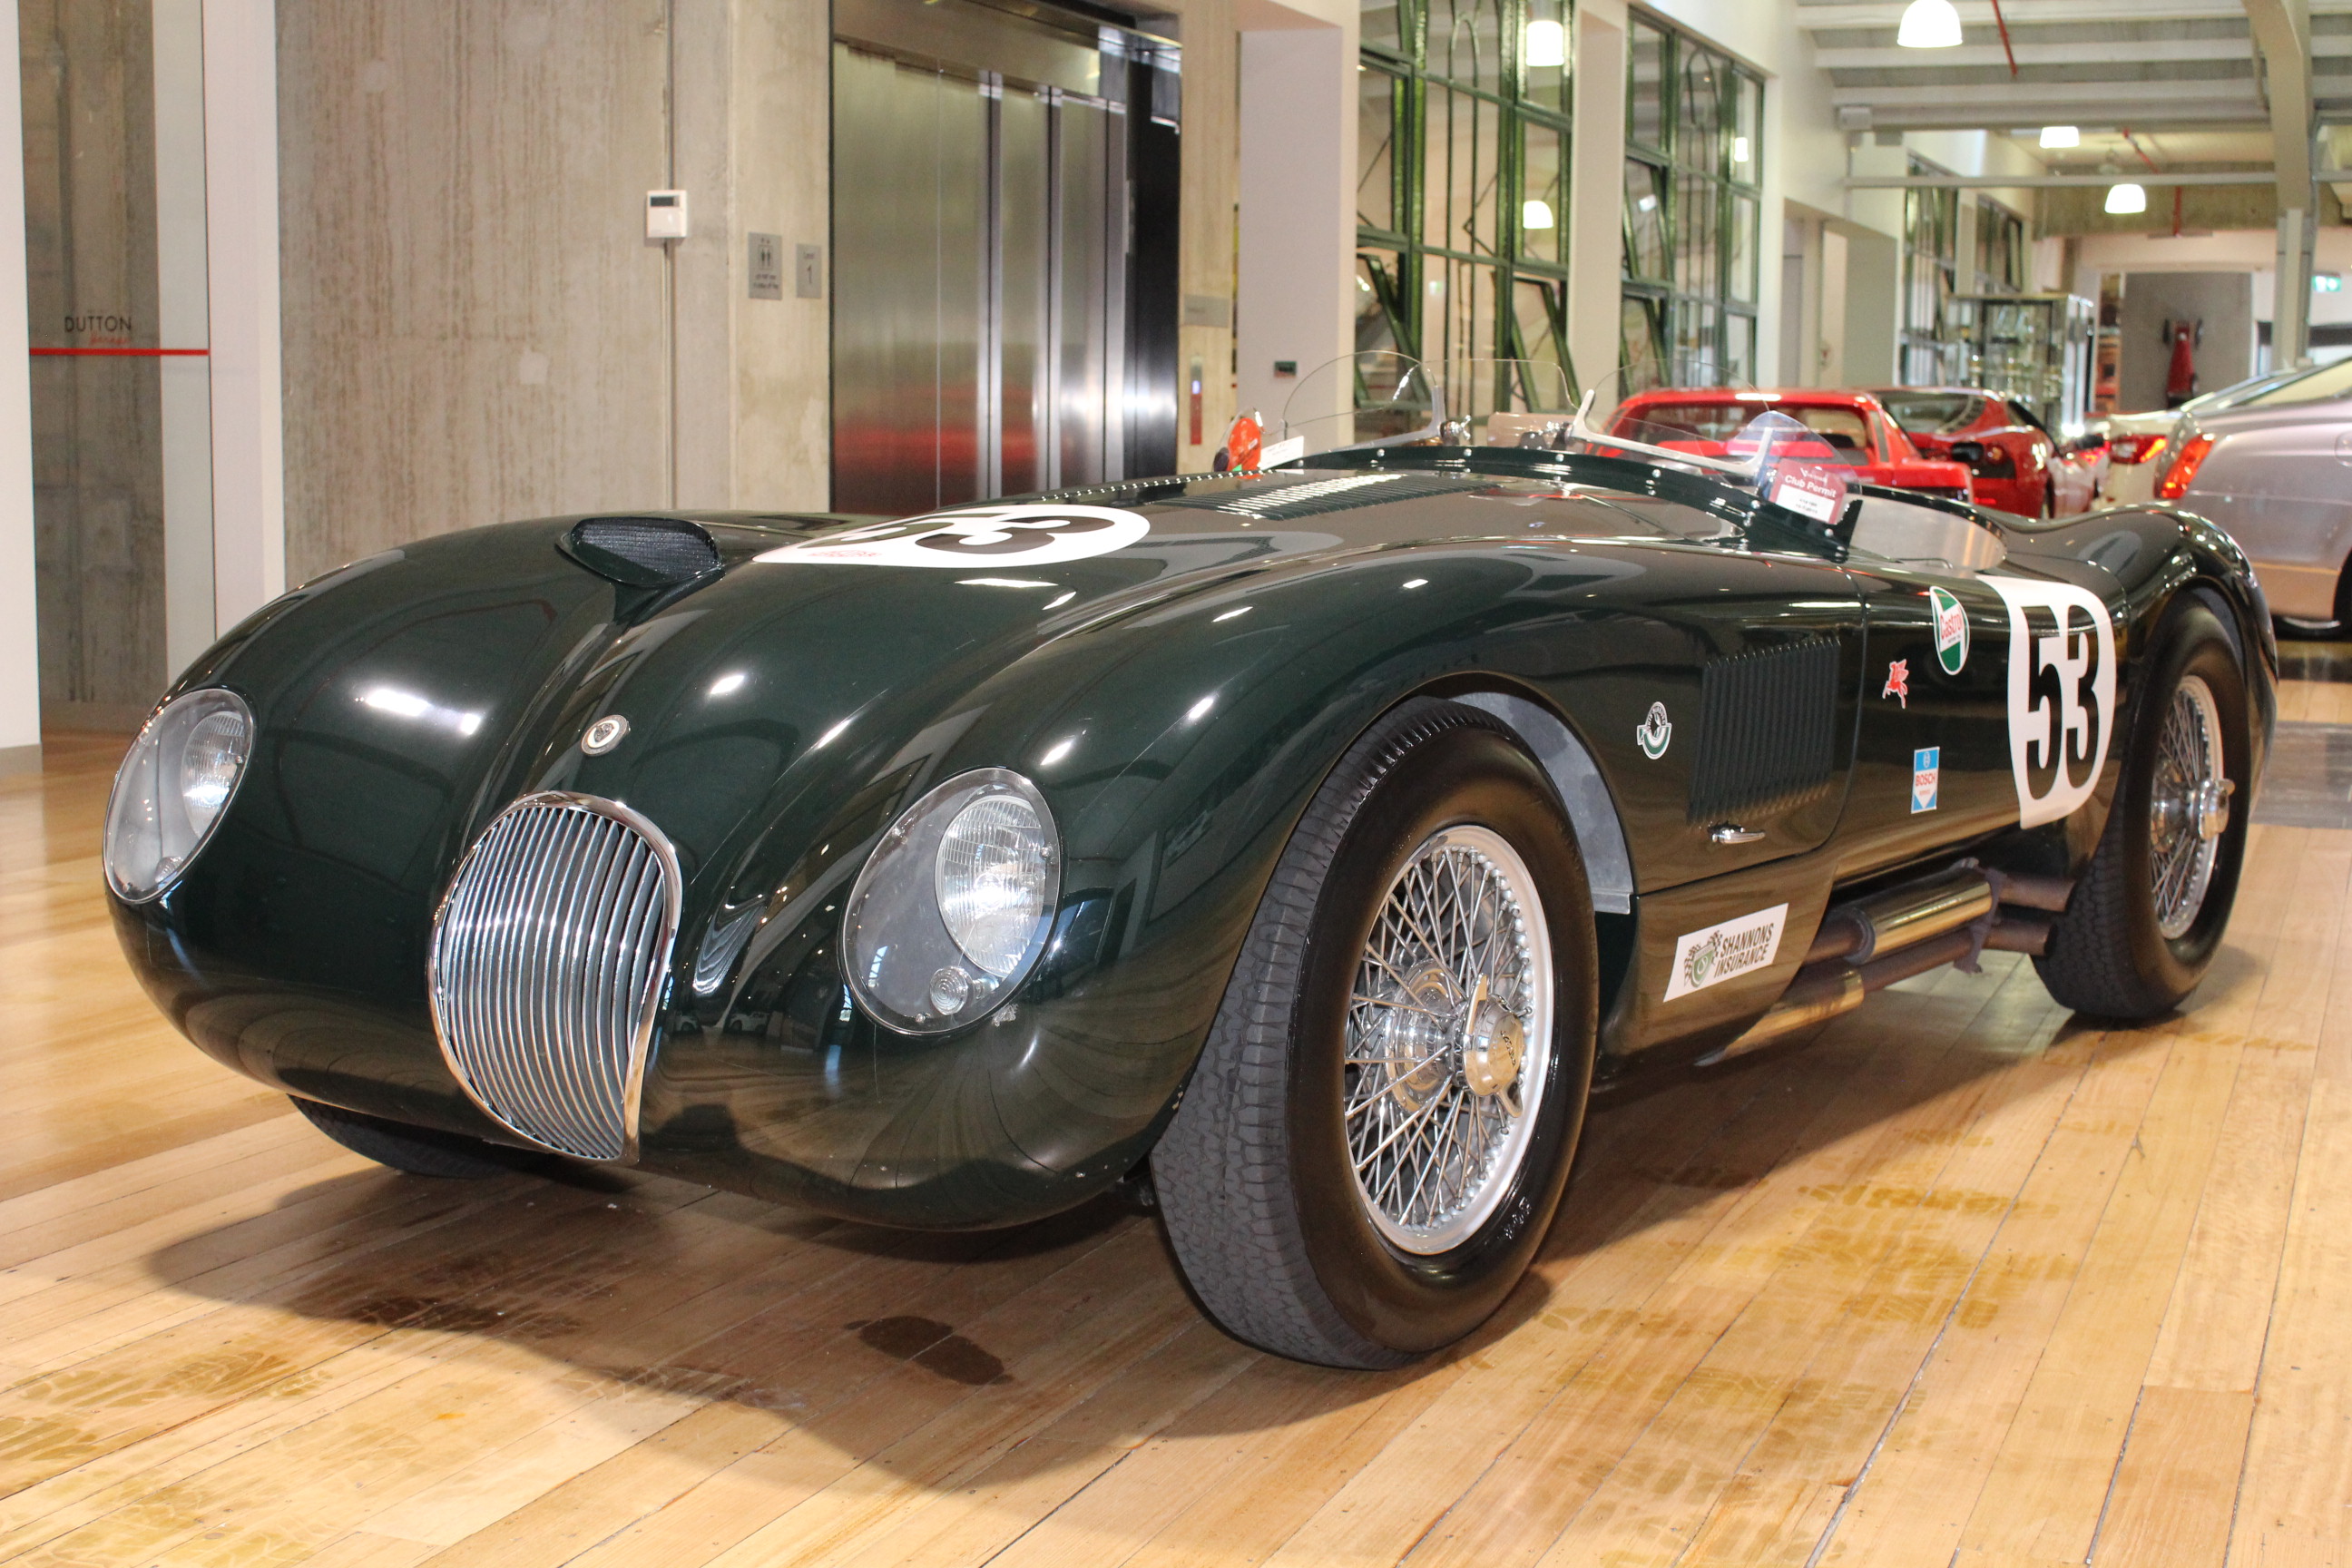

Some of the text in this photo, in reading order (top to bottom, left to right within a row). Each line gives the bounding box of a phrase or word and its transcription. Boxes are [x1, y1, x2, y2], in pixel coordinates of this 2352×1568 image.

[64, 315, 132, 333] DUTTON
[1784, 474, 1806, 488] Club
[1807, 481, 1837, 498] Permit
[797, 513, 1115, 554] 53
[1939, 613, 1964, 640] Castrol
[2020, 604, 2100, 800] 53
[1915, 771, 1936, 787] BOSCH
[1720, 922, 1775, 957] SHANNONS
[1714, 944, 1769, 978] INSURANCE
